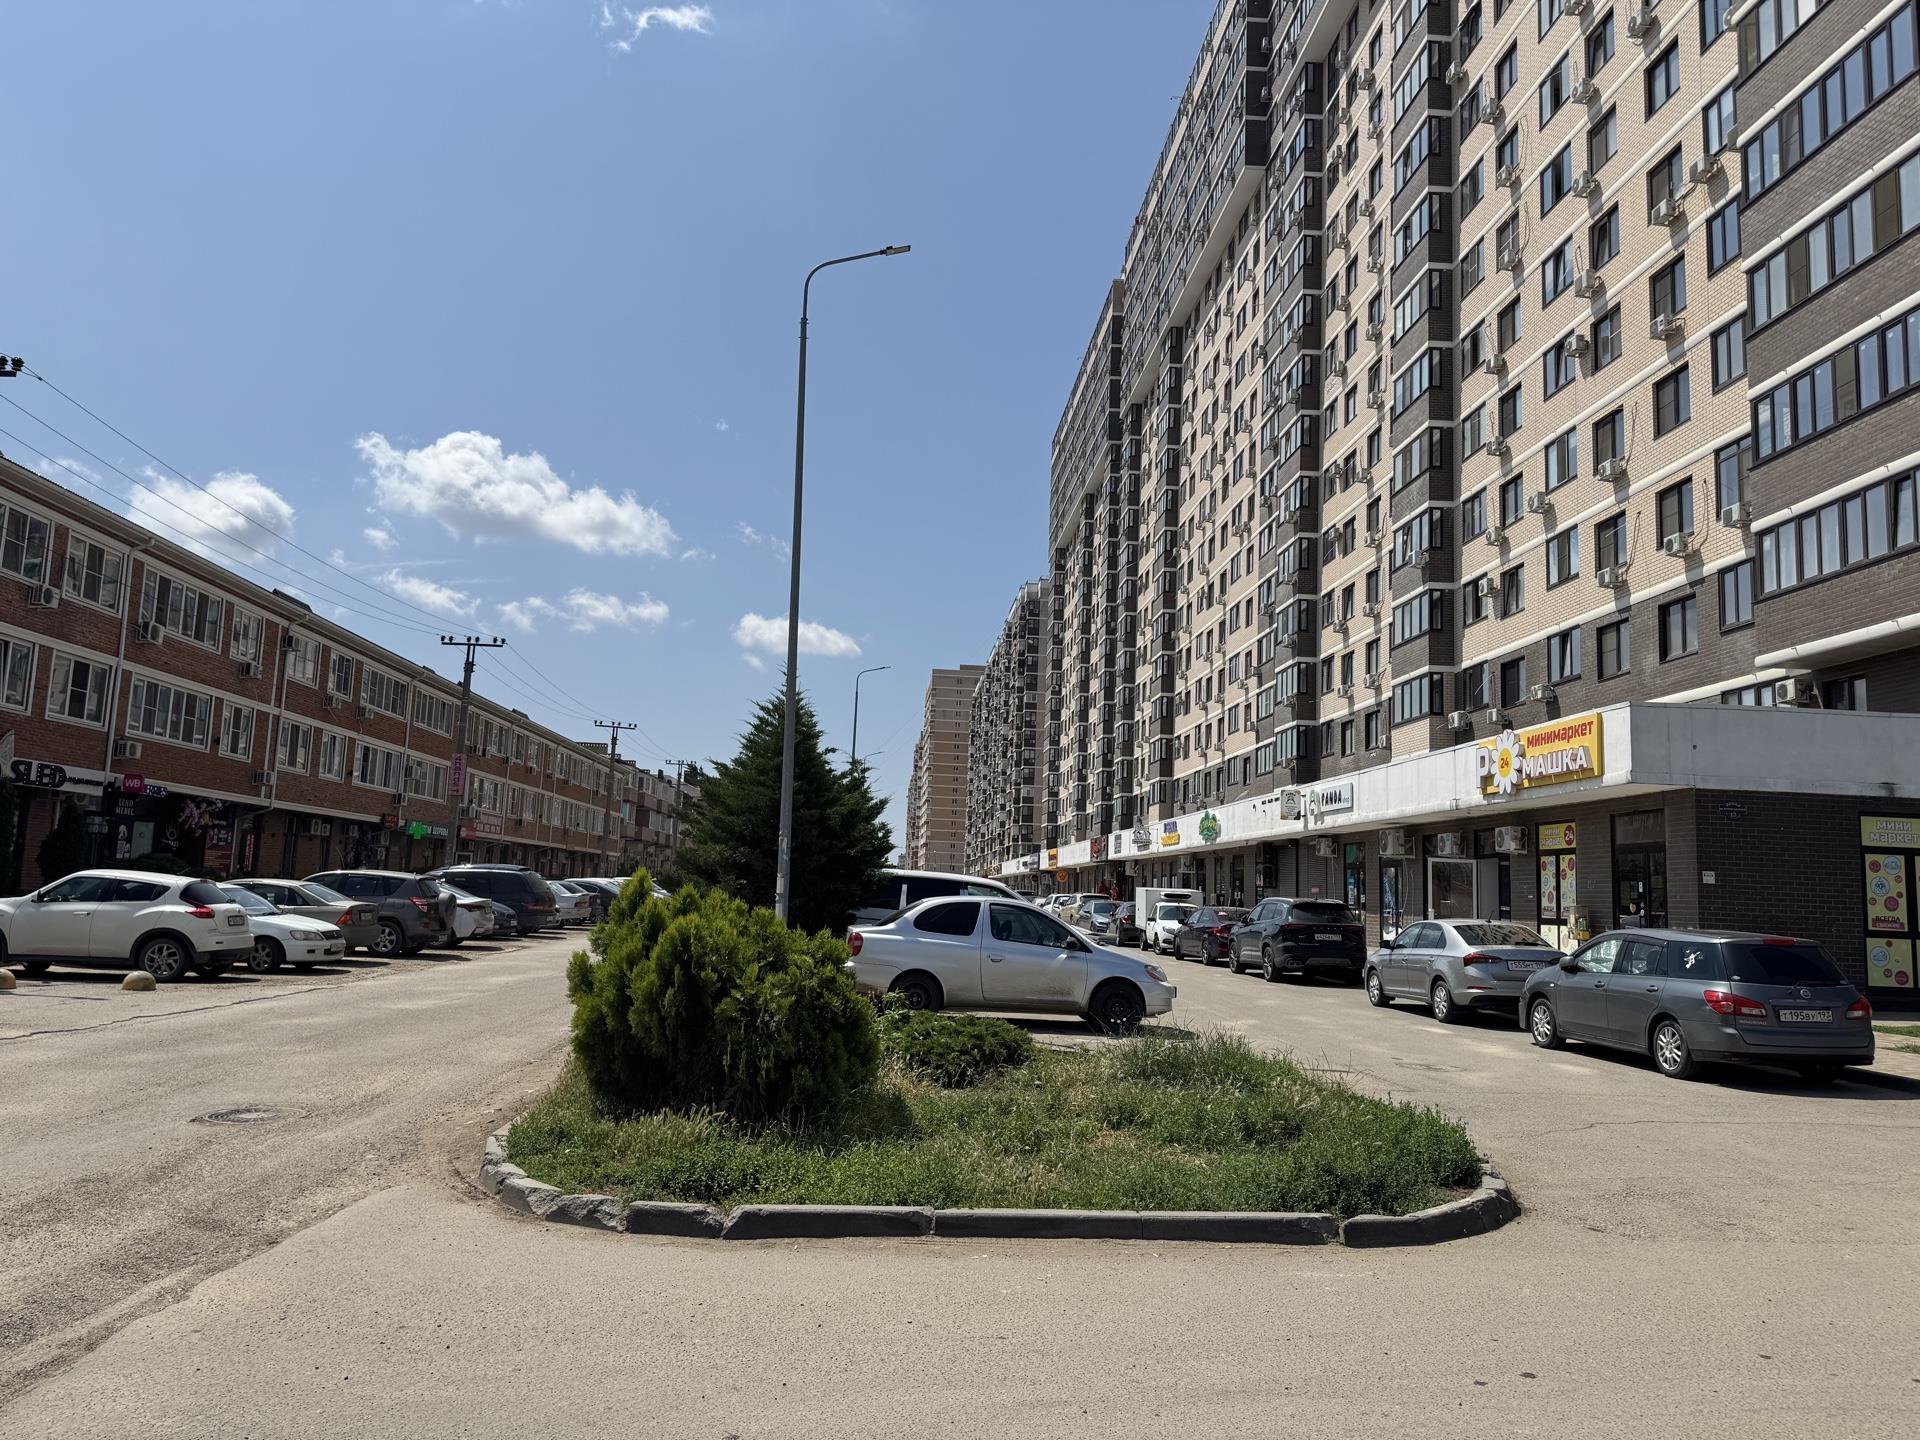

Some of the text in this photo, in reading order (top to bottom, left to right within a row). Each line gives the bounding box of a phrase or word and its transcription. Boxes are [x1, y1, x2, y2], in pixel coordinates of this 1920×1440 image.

[1500, 758, 1509, 768] 24
[125, 778, 141, 788] WB
[1321, 789, 1342, 807] PANDA
[1565, 830, 1574, 841] 24
